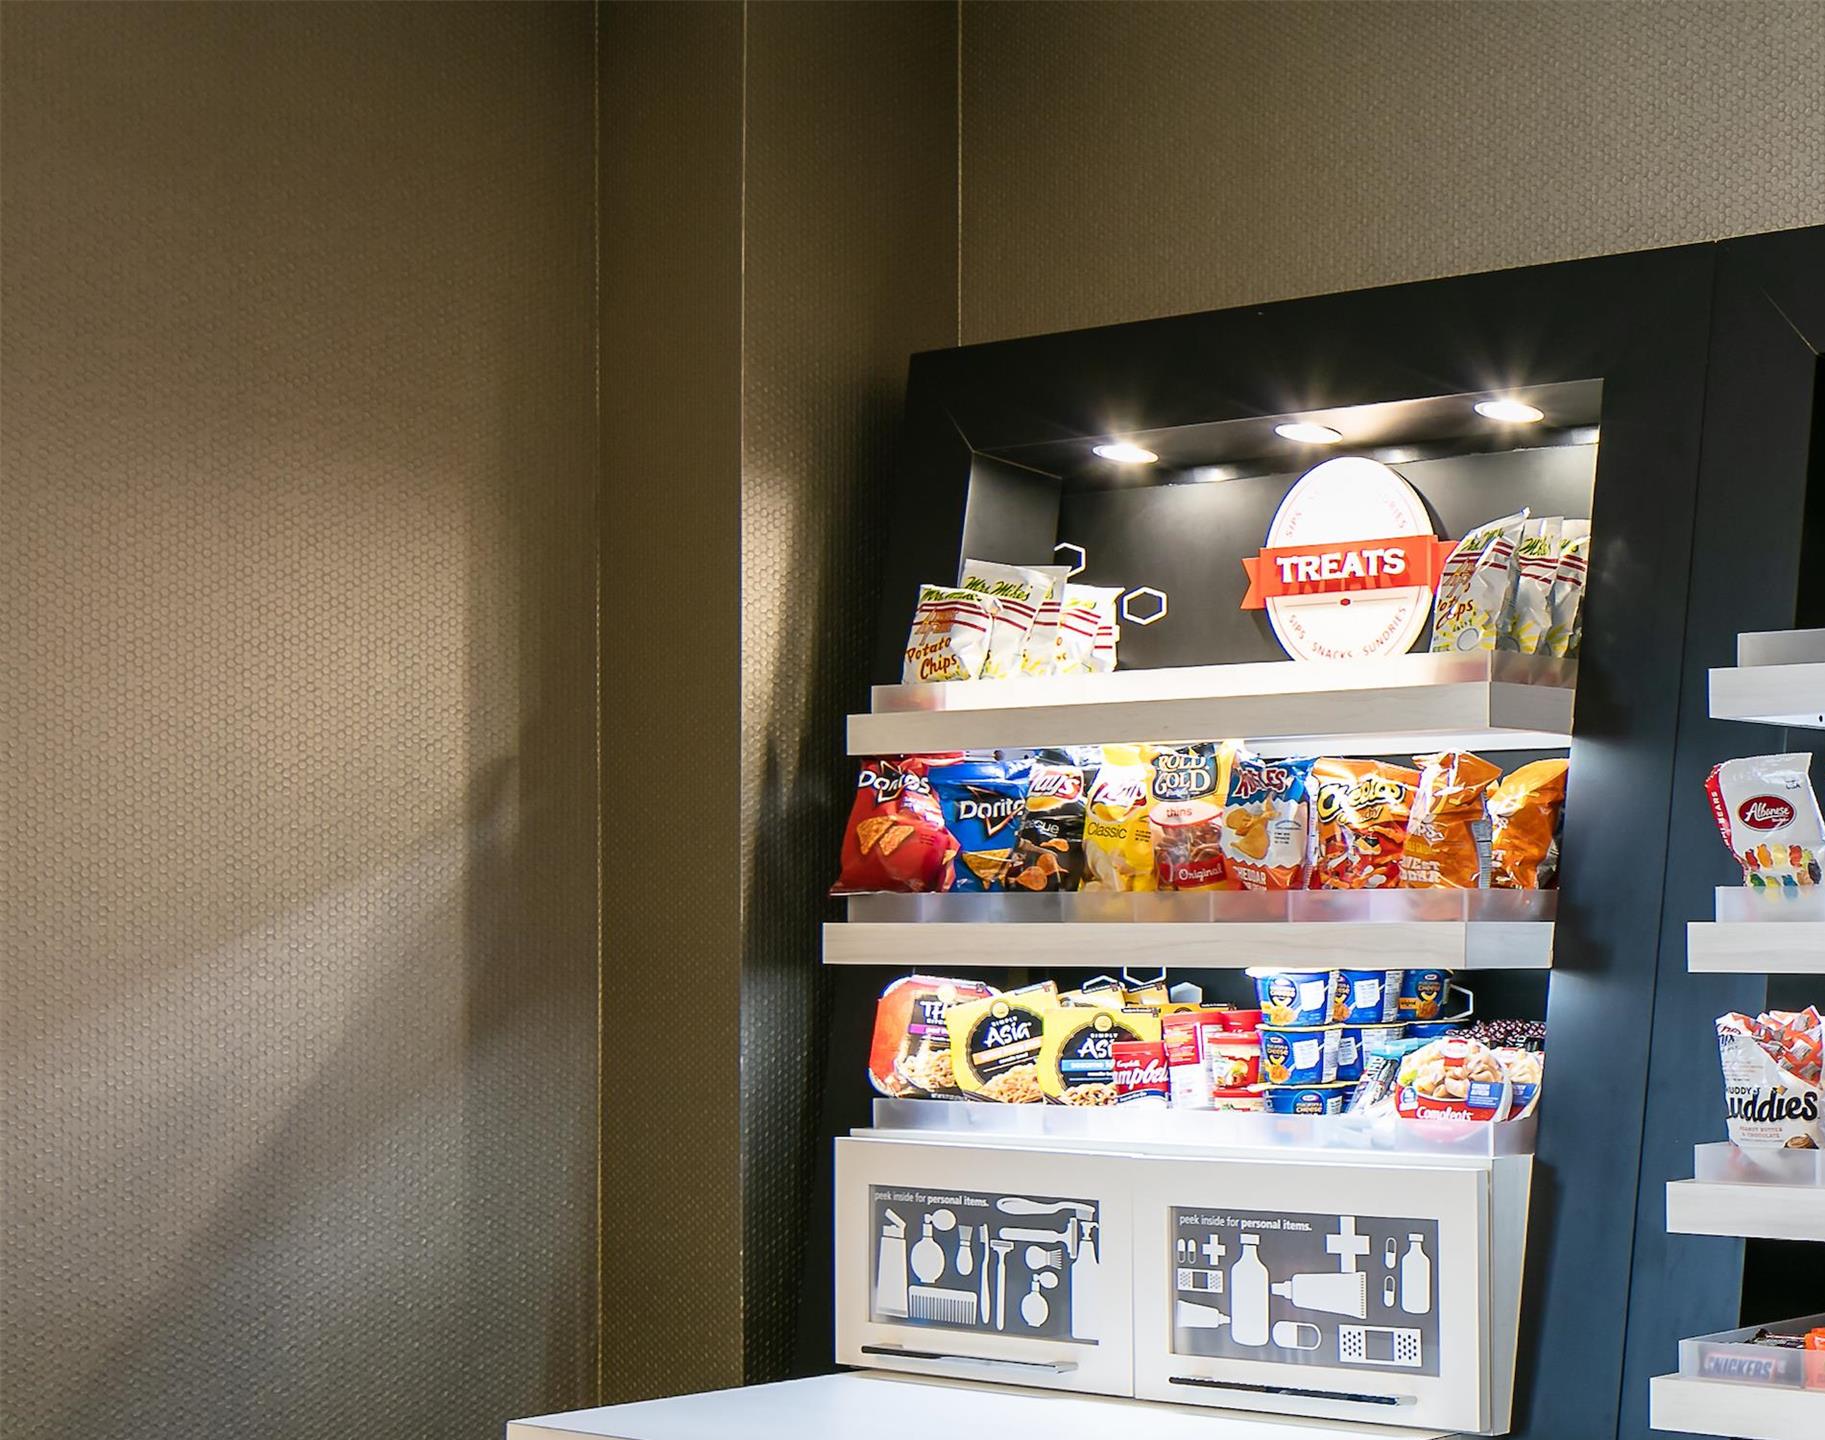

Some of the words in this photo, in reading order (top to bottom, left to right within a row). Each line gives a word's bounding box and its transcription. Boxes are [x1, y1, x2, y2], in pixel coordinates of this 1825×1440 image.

[1275, 547, 1406, 584] TREATS
[1288, 613, 1306, 641] SIPS
[1312, 641, 1353, 659] SNACKS
[1363, 606, 1407, 657] SUNDRIES
[906, 636, 952, 663] Potato
[920, 653, 958, 680] Chips
[1154, 768, 1211, 795] GOLD
[1166, 807, 1193, 818] thins
[1086, 821, 1128, 840] Classic
[1178, 865, 1223, 882] Original
[874, 1191, 892, 1202] peek
[892, 1191, 914, 1202] inside
[915, 1192, 926, 1203] for
[926, 1195, 962, 1206] personal
[963, 1196, 990, 1207] items.
[1179, 1214, 1200, 1226] peek
[1200, 1215, 1225, 1227] inside
[1226, 1216, 1240, 1227] for
[1240, 1218, 1281, 1230] personal
[1282, 1219, 1313, 1231] items.
